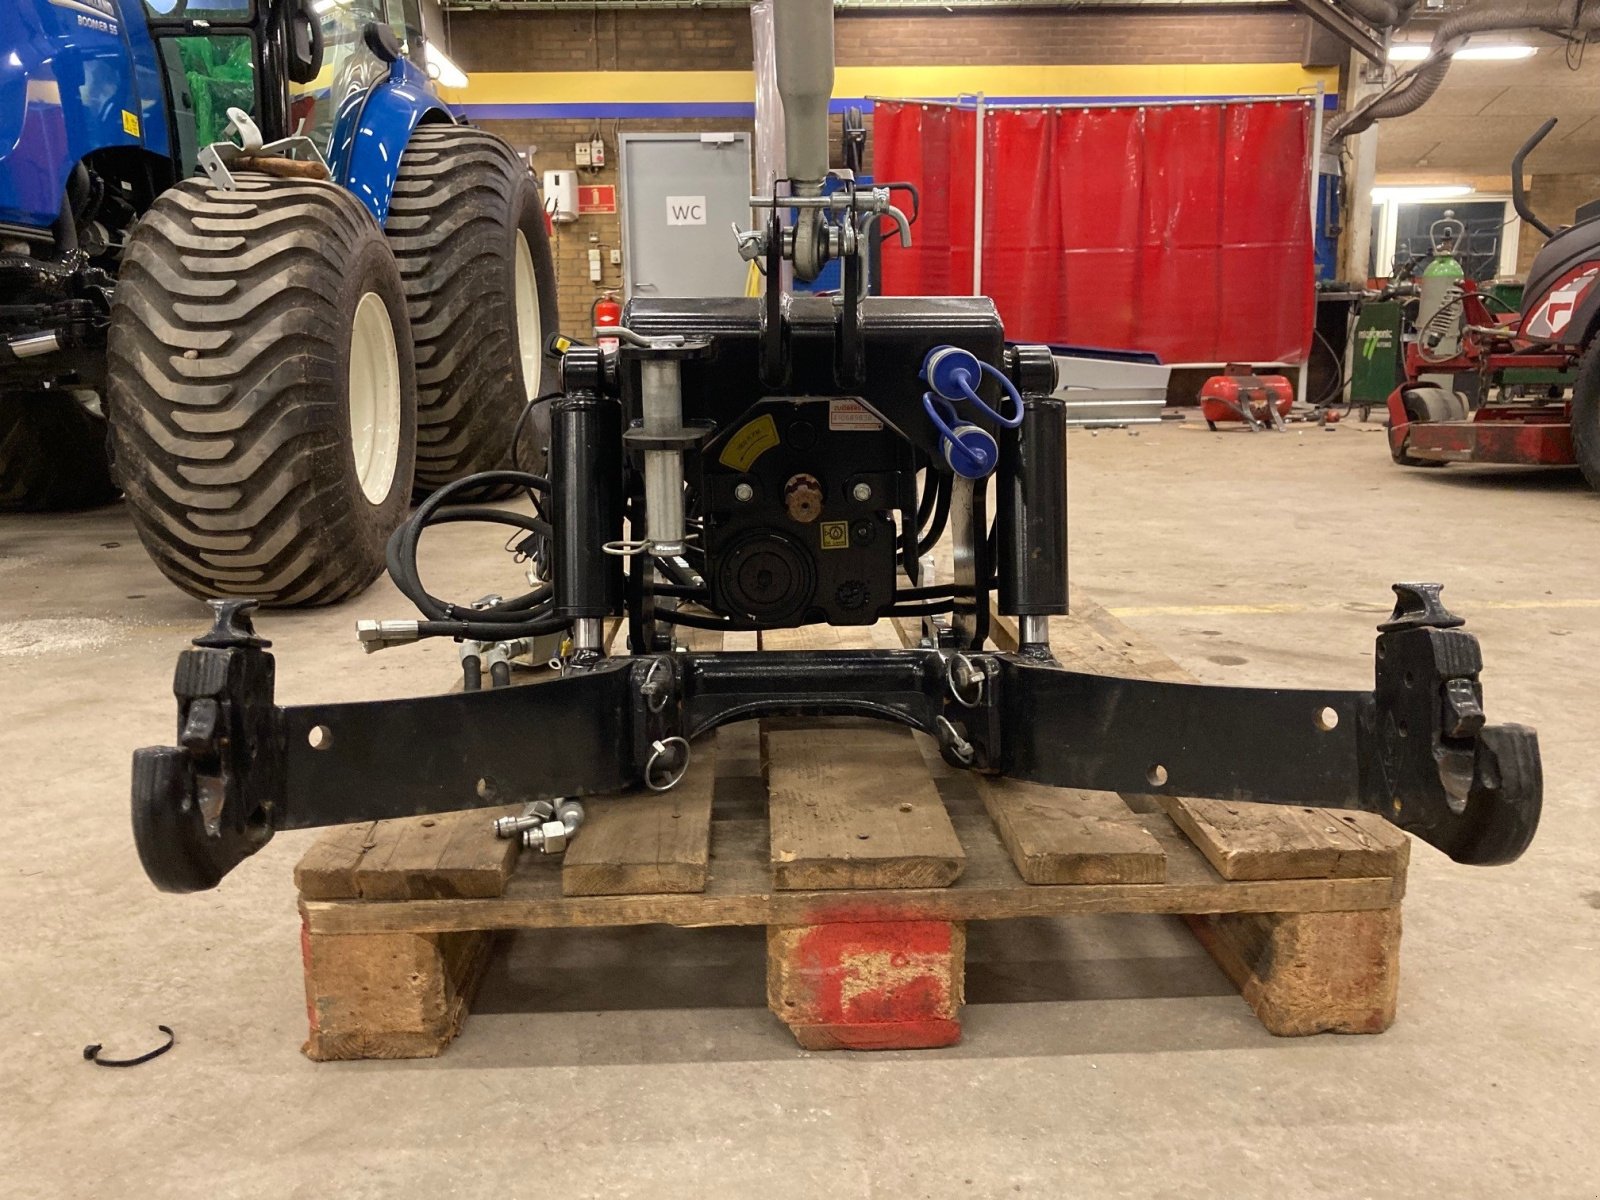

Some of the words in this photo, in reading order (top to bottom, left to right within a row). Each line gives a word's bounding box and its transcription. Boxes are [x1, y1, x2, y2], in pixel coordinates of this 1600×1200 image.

[77, 14, 107, 31] BOOMER
[109, 23, 118, 35] 55
[672, 205, 701, 219] WC
